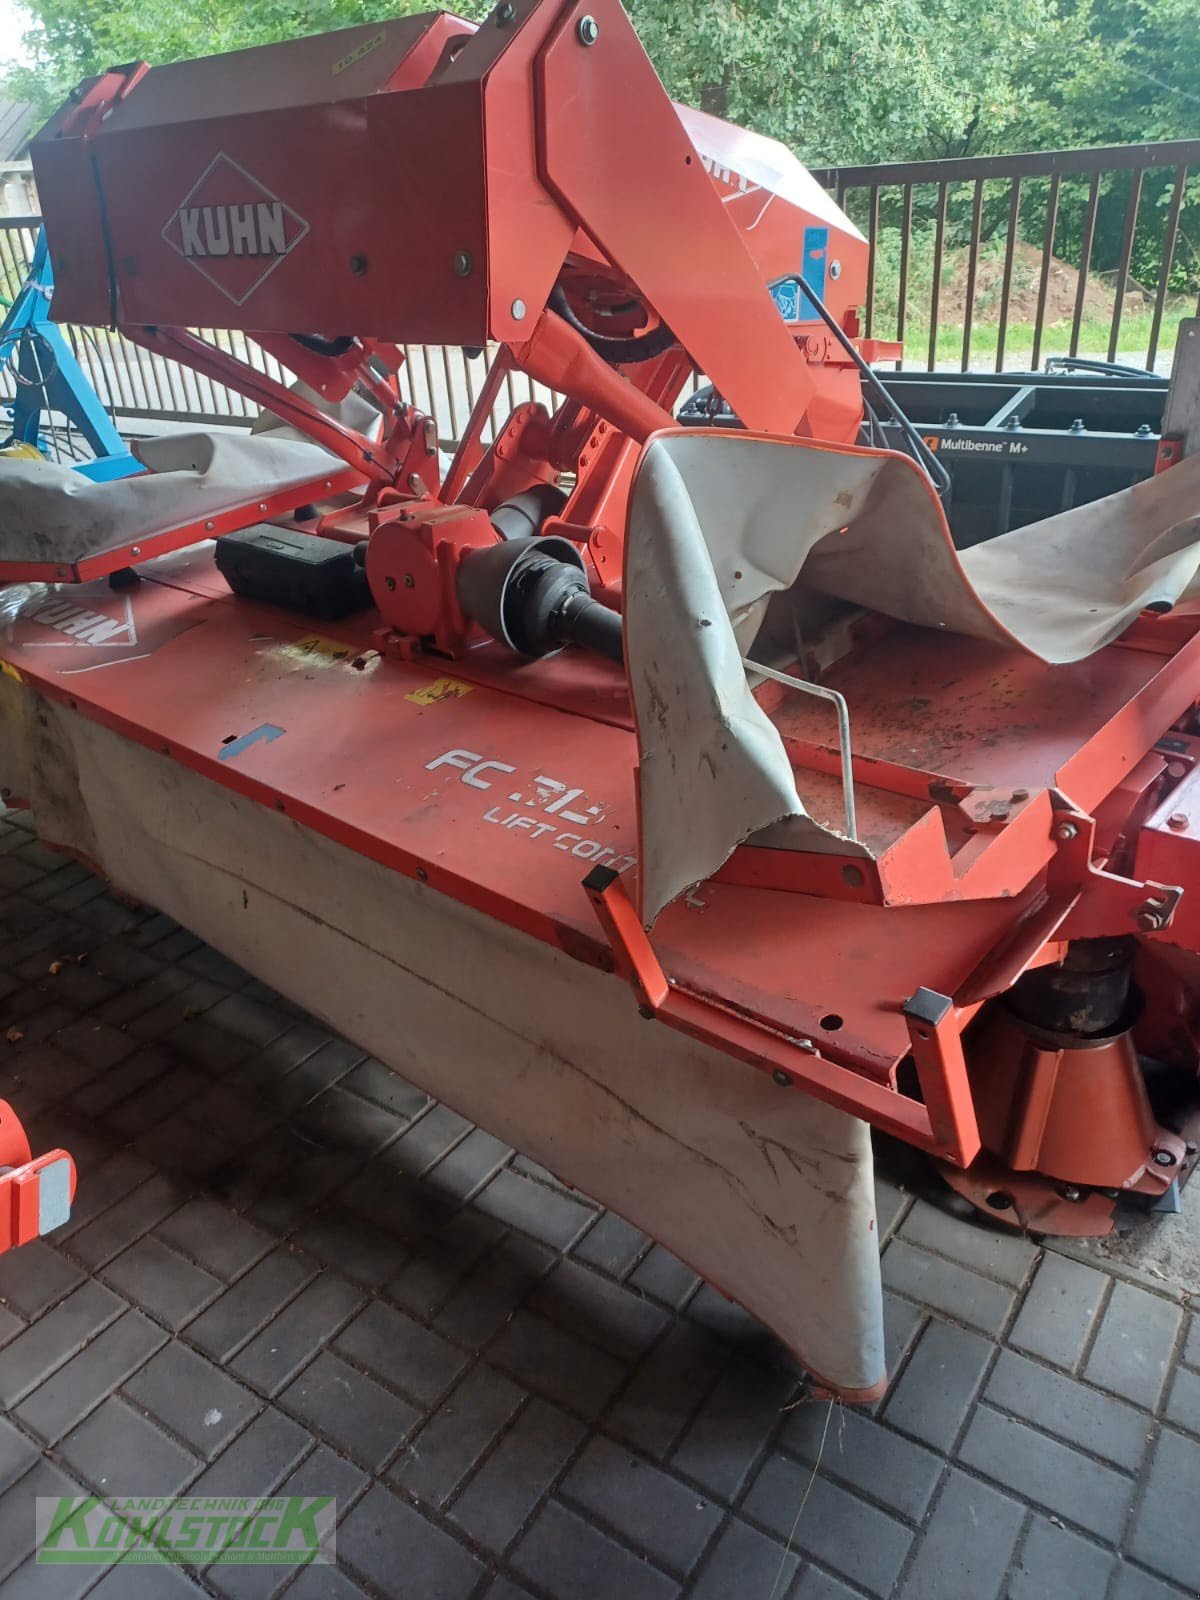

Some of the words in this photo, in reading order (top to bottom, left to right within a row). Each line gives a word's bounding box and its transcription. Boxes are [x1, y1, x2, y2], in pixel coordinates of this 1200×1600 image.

[179, 202, 286, 256] KUHN
[1009, 442, 1029, 453] M+
[425, 749, 517, 790] FC
[483, 806, 557, 838] LIFT
